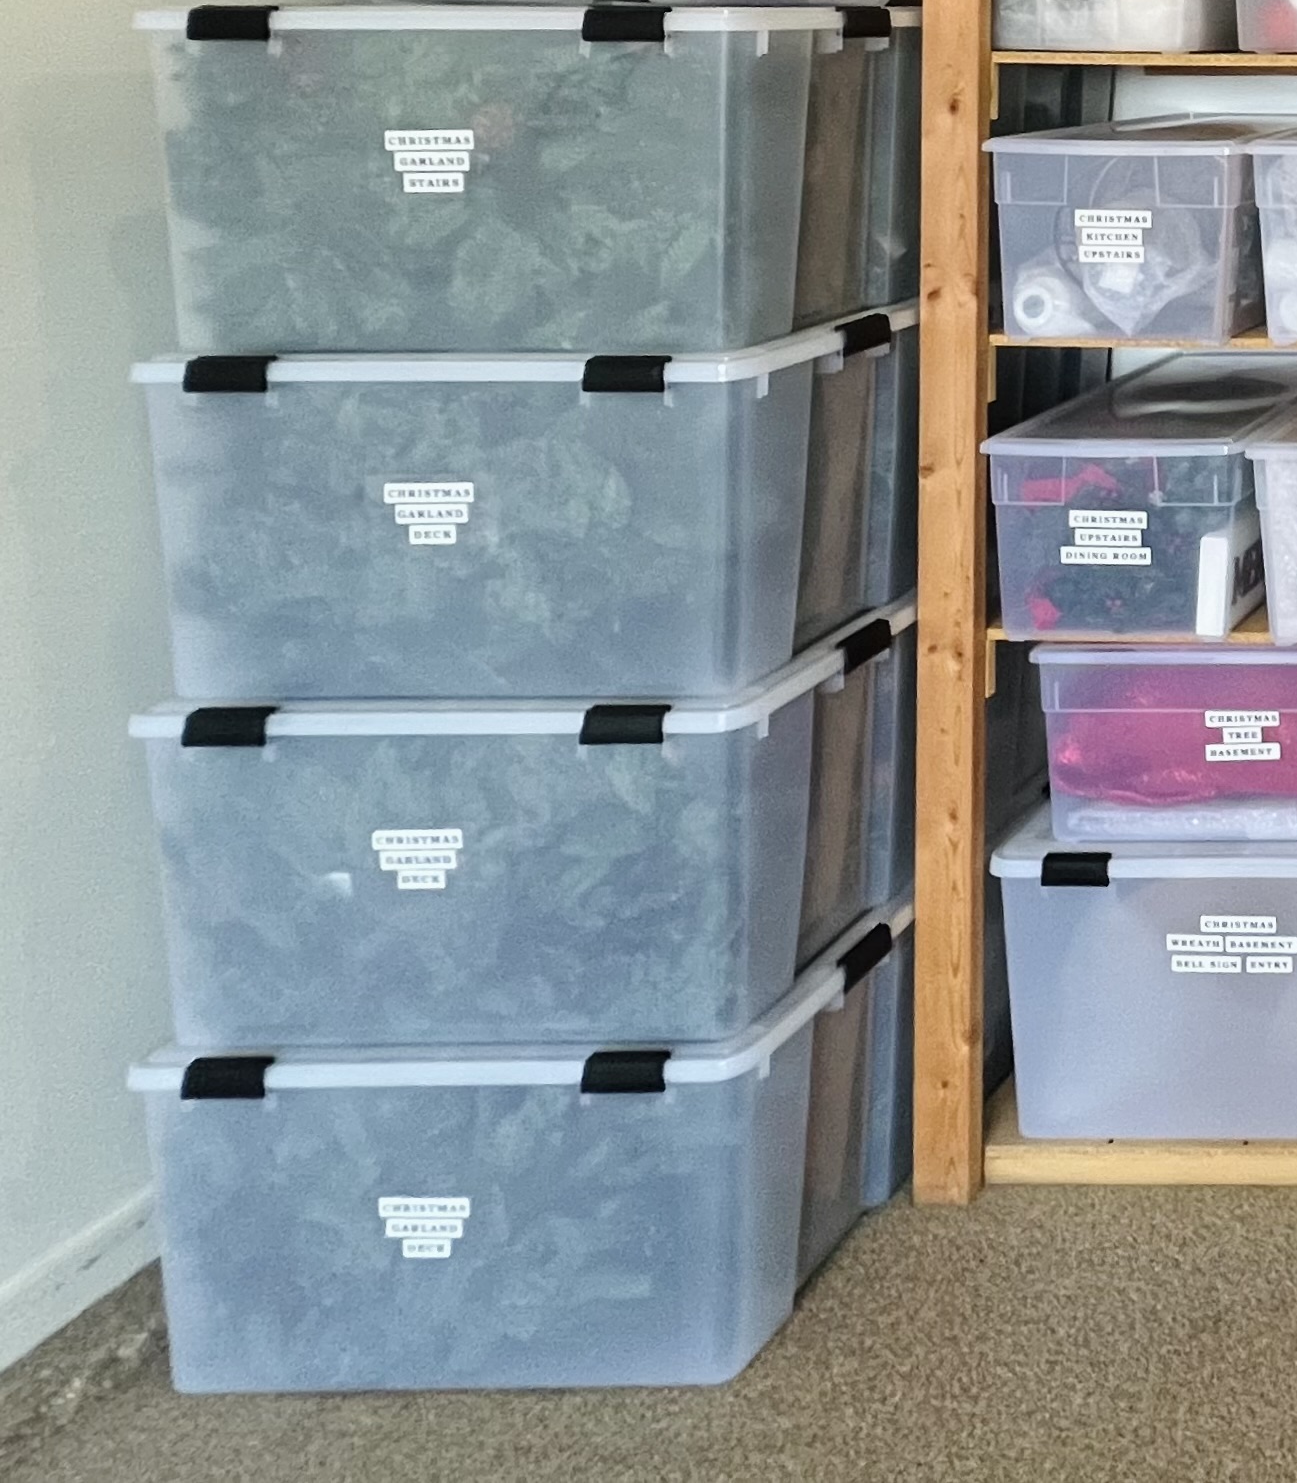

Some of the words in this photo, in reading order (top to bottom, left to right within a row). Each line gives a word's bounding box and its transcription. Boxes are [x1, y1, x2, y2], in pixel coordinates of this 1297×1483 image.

[388, 136, 471, 146] CHRISTMAS
[399, 157, 465, 166] GARLAND
[409, 178, 459, 188] STAIRS
[1079, 215, 1148, 223] CHRISTMAS
[1086, 233, 1138, 241] KITCHEN
[1083, 250, 1141, 259] UPSTAIRS
[388, 489, 471, 498] CHRISTMAS
[396, 509, 464, 519] GARLAND
[1073, 516, 1143, 524] CHRISTMAS
[413, 530, 452, 539] DECK
[1079, 534, 1138, 542] UPSTAIRS
[1065, 552, 1108, 560] DINING
[1112, 552, 1147, 560] ROOM
[1209, 714, 1278, 723] CHRISTMAS
[1228, 731, 1258, 739] TREE
[1210, 748, 1272, 757] BASEMENT
[1204, 921, 1274, 929] CHRISTMAS
[1171, 939, 1220, 947] WREATH
[1230, 941, 1293, 949] BASEMENT
[1175, 959, 1205, 968] BELL
[1210, 961, 1238, 969] SIGN
[1250, 961, 1288, 969] ENTRY
